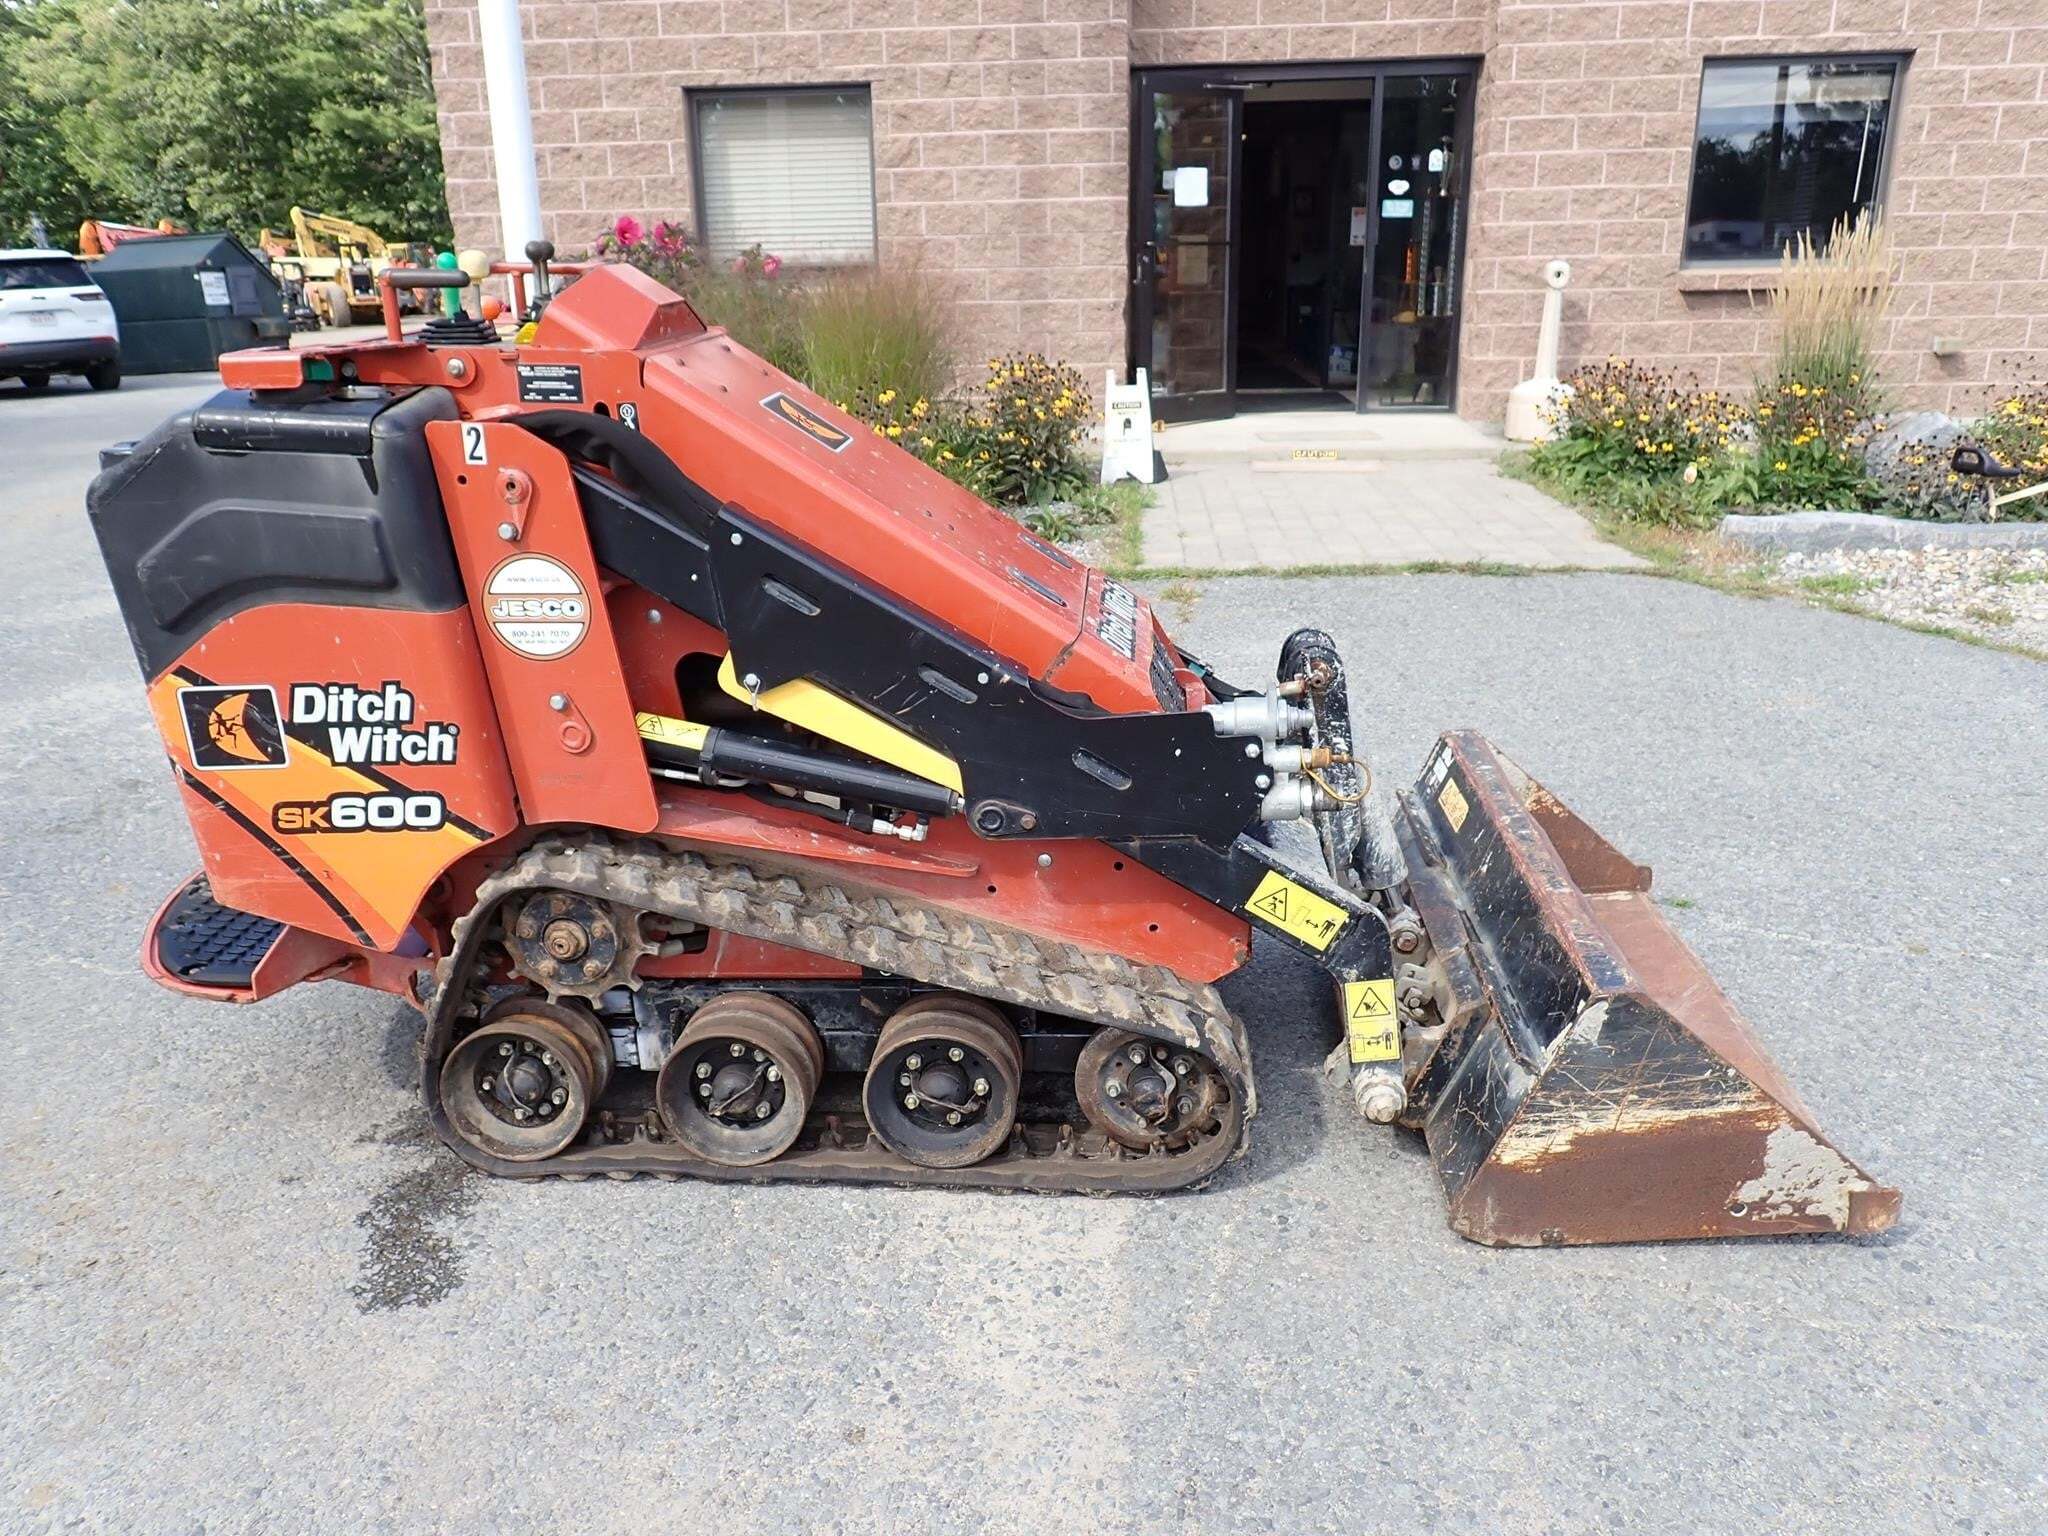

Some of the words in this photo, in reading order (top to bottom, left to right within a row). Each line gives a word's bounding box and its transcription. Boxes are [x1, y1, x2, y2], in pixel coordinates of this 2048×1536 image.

[467, 426, 483, 460] 2
[491, 599, 583, 618] JESCO
[1099, 612, 1132, 659] Ditch
[292, 685, 411, 723] Ditch
[277, 796, 442, 829] SK600
